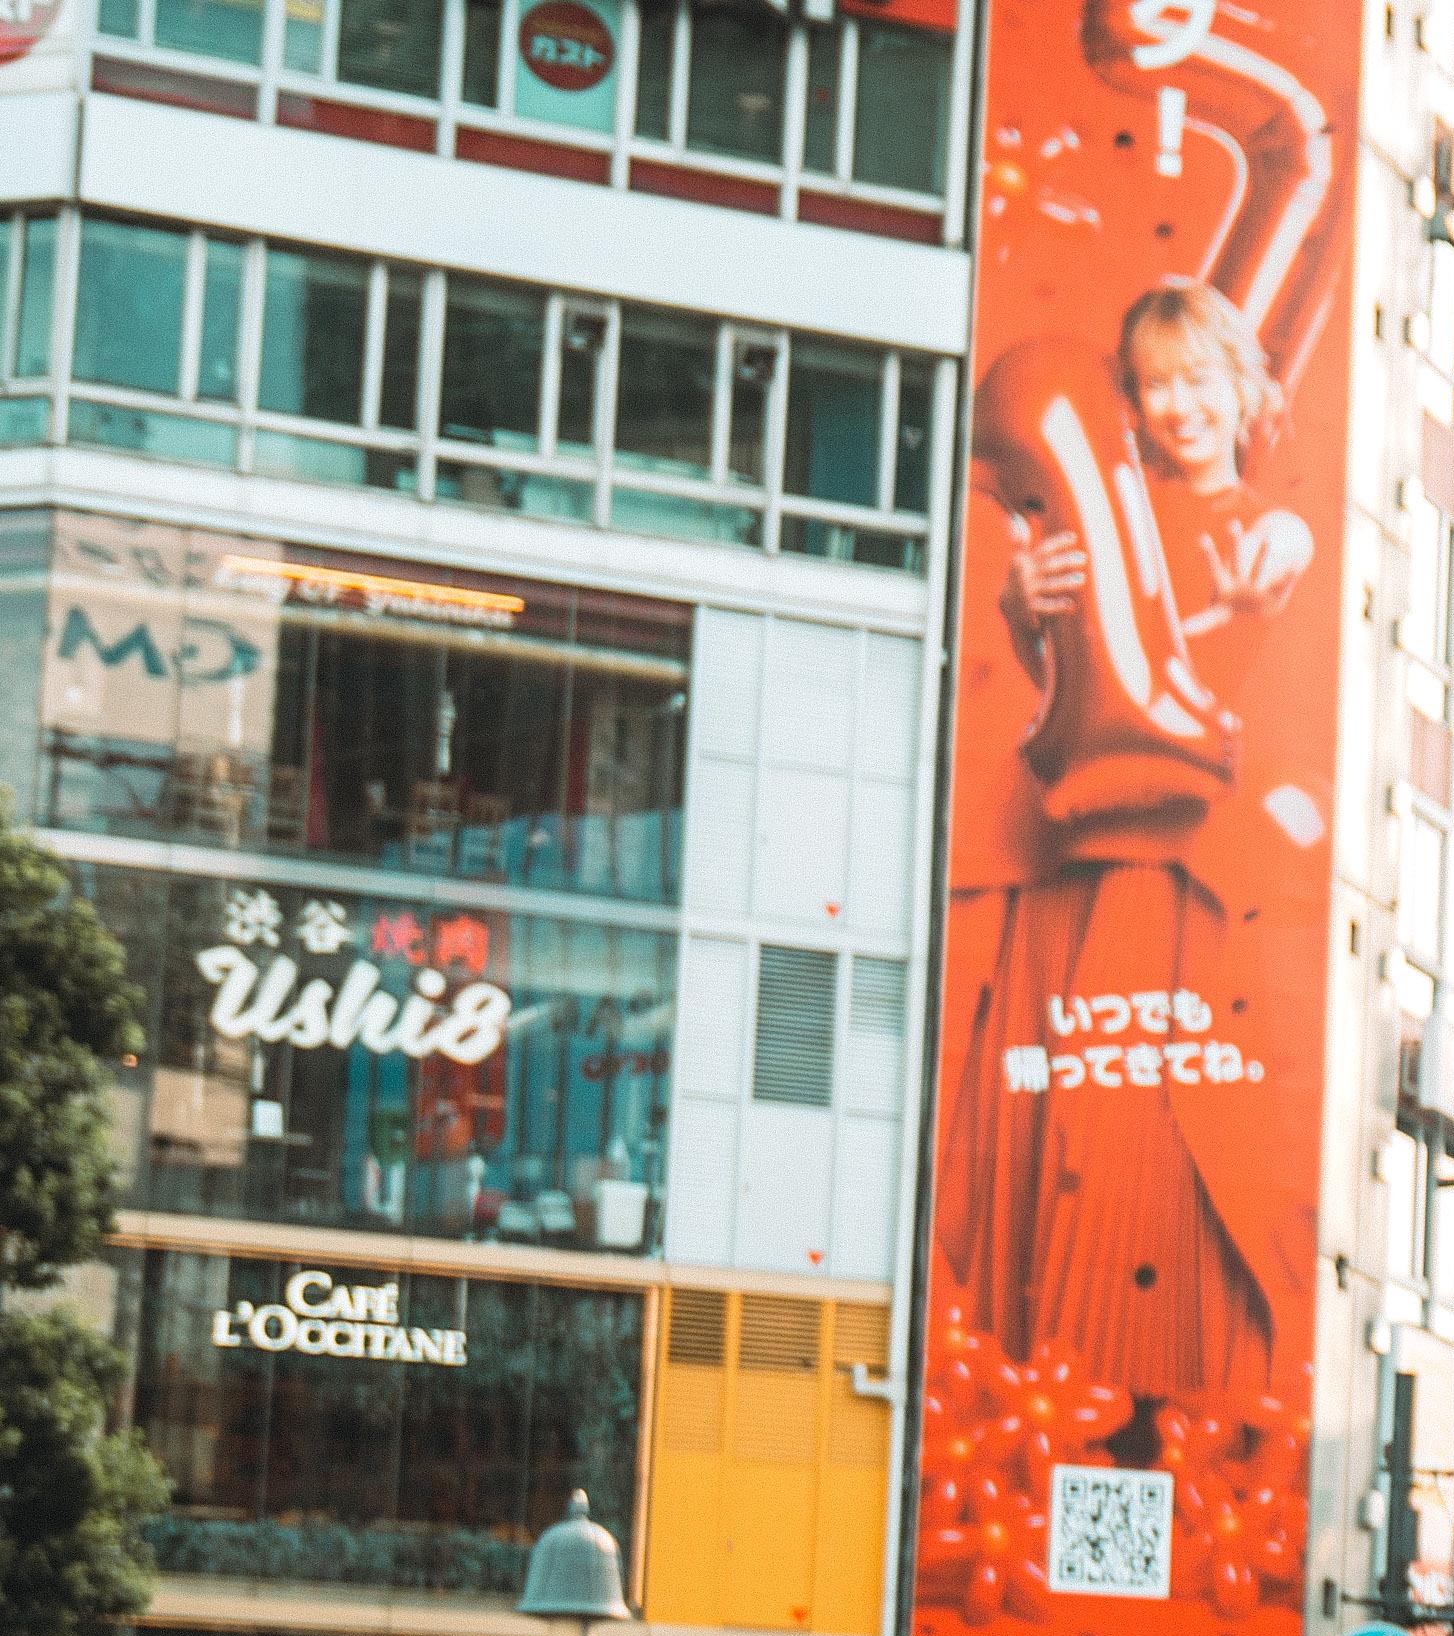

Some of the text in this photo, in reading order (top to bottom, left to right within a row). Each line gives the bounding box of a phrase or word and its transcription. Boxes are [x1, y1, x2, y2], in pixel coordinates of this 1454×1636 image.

[1050, 990, 1212, 1036] いつでも
[1004, 1042, 1264, 1092] 帰ってきてね。
[286, 1270, 399, 1323] CAFÉ
